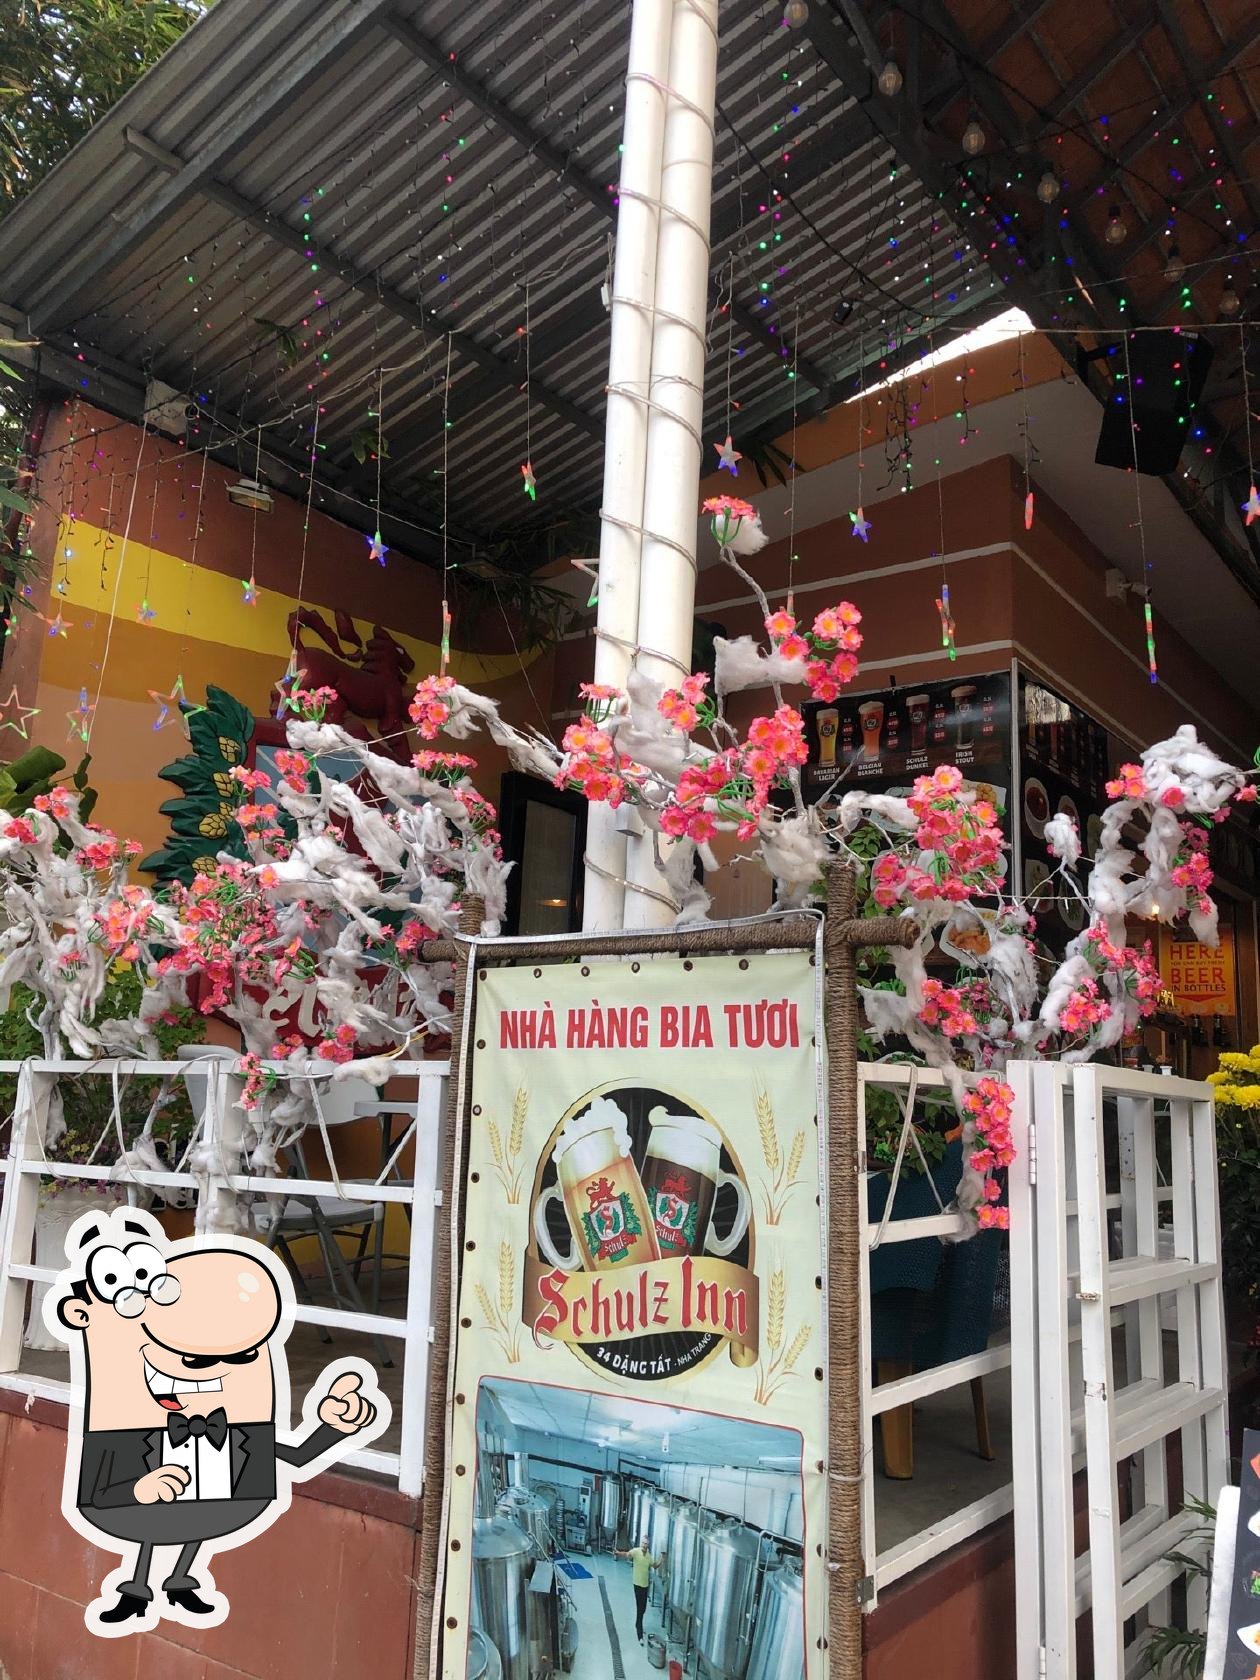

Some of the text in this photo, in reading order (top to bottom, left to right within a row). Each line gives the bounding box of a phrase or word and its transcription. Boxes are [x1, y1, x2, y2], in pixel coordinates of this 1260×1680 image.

[955, 756, 975, 765] STOUT
[1170, 944, 1225, 960] HERE
[1171, 967, 1226, 984] BEER
[1171, 984, 1226, 992] IN BOTTLES
[500, 998, 800, 1049] NHÀ HÀNG BIA TƯƠI
[534, 1255, 748, 1350] Schulz Inn
[596, 1347, 611, 1363] 34
[649, 1353, 672, 1374] TẤT
[677, 1354, 692, 1367] NHA
[690, 1332, 711, 1357] TRANG
